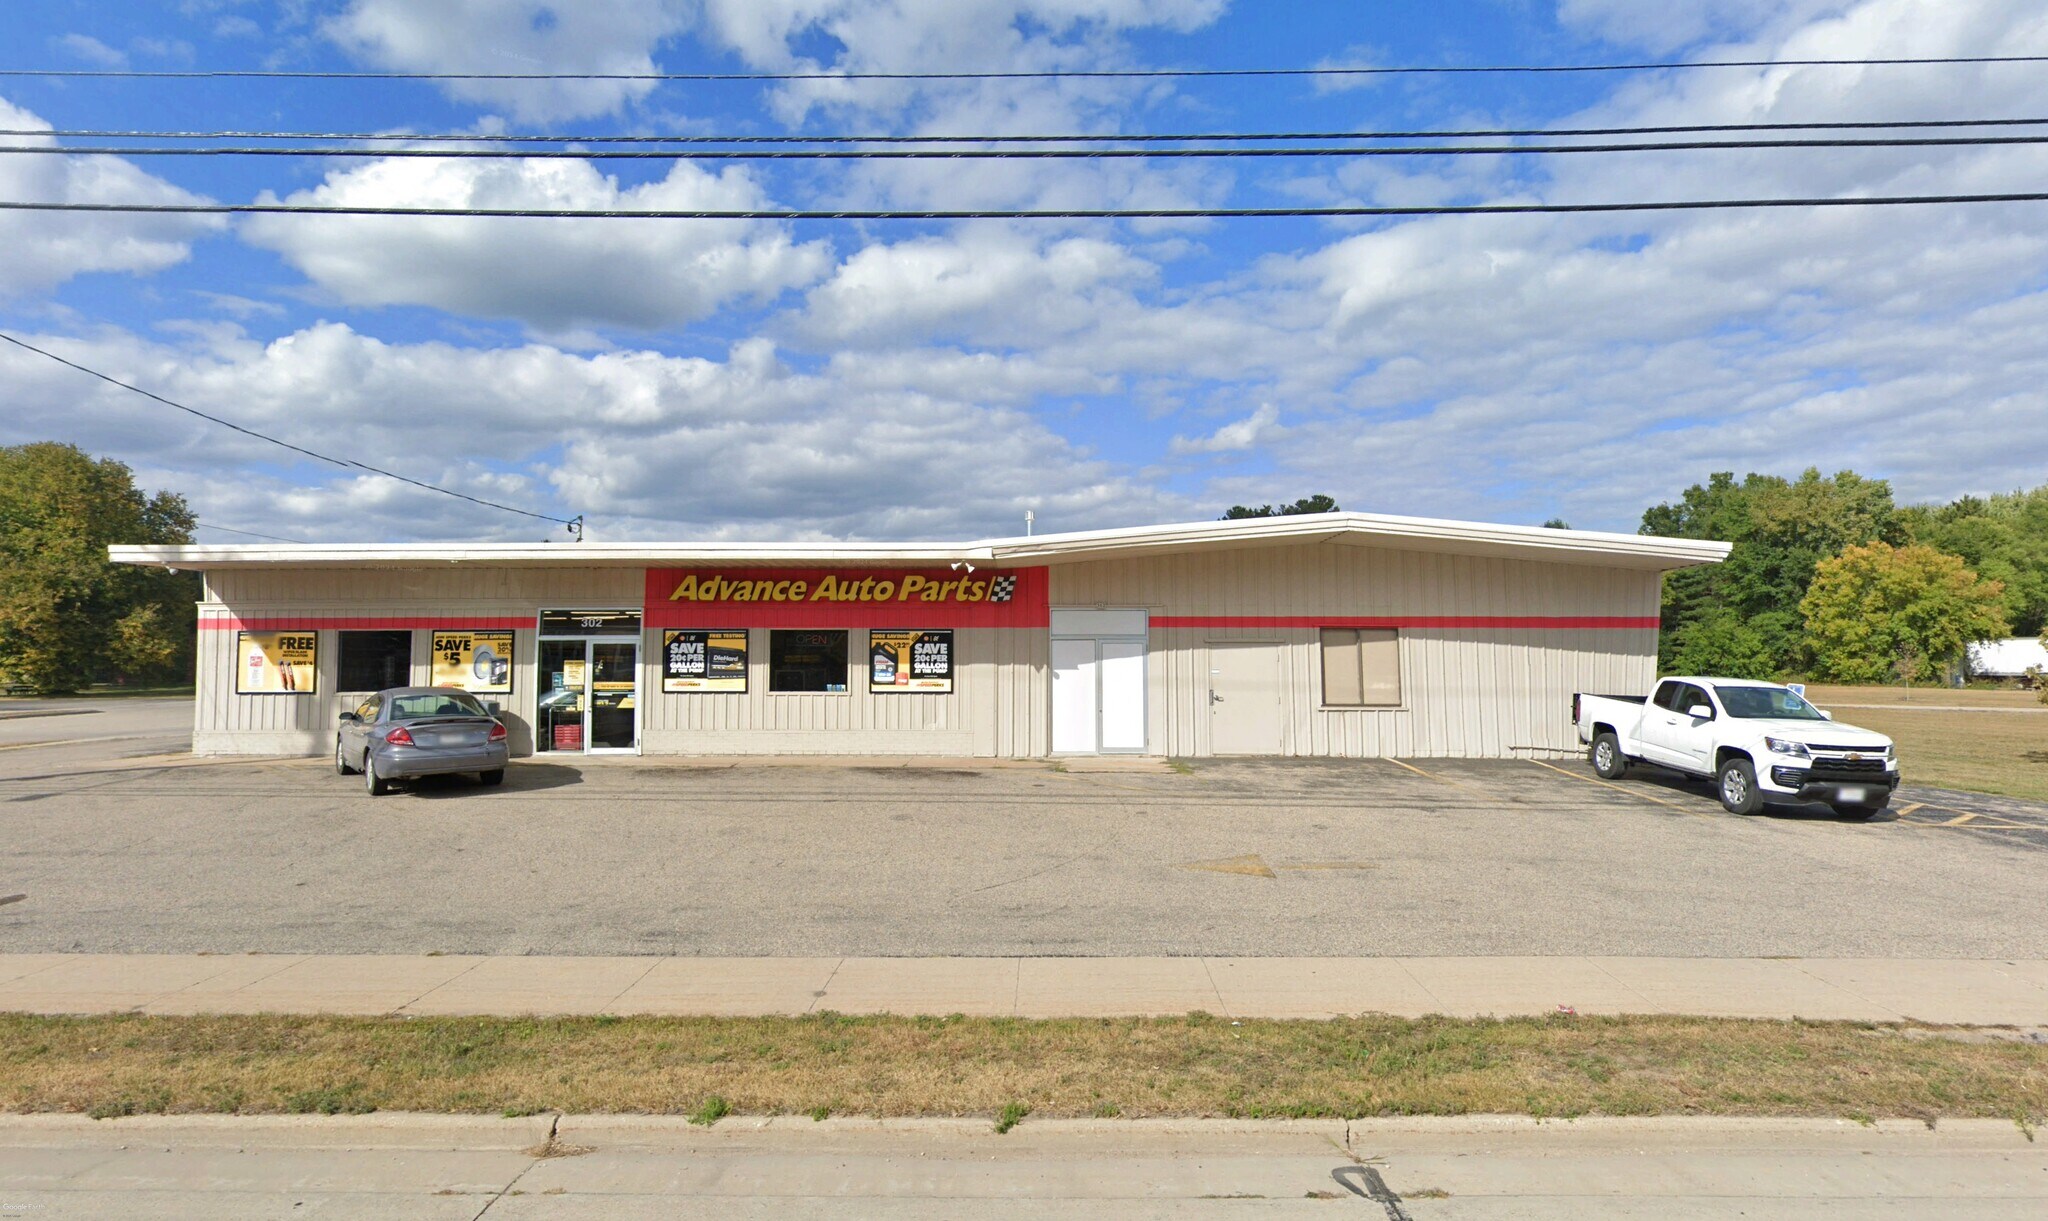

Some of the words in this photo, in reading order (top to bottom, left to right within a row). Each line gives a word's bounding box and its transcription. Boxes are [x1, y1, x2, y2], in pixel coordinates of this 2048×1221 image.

[670, 575, 806, 602] Advance
[809, 575, 894, 602] Auto
[898, 575, 986, 602] Parts
[581, 618, 602, 628] 302
[278, 636, 314, 650] FREE
[435, 639, 471, 651] SAVE
[796, 634, 827, 645] OPEN
[670, 642, 705, 654] SAVE
[914, 643, 948, 654] SAVE
[443, 652, 461, 667] $5
[687, 654, 705, 662] PER
